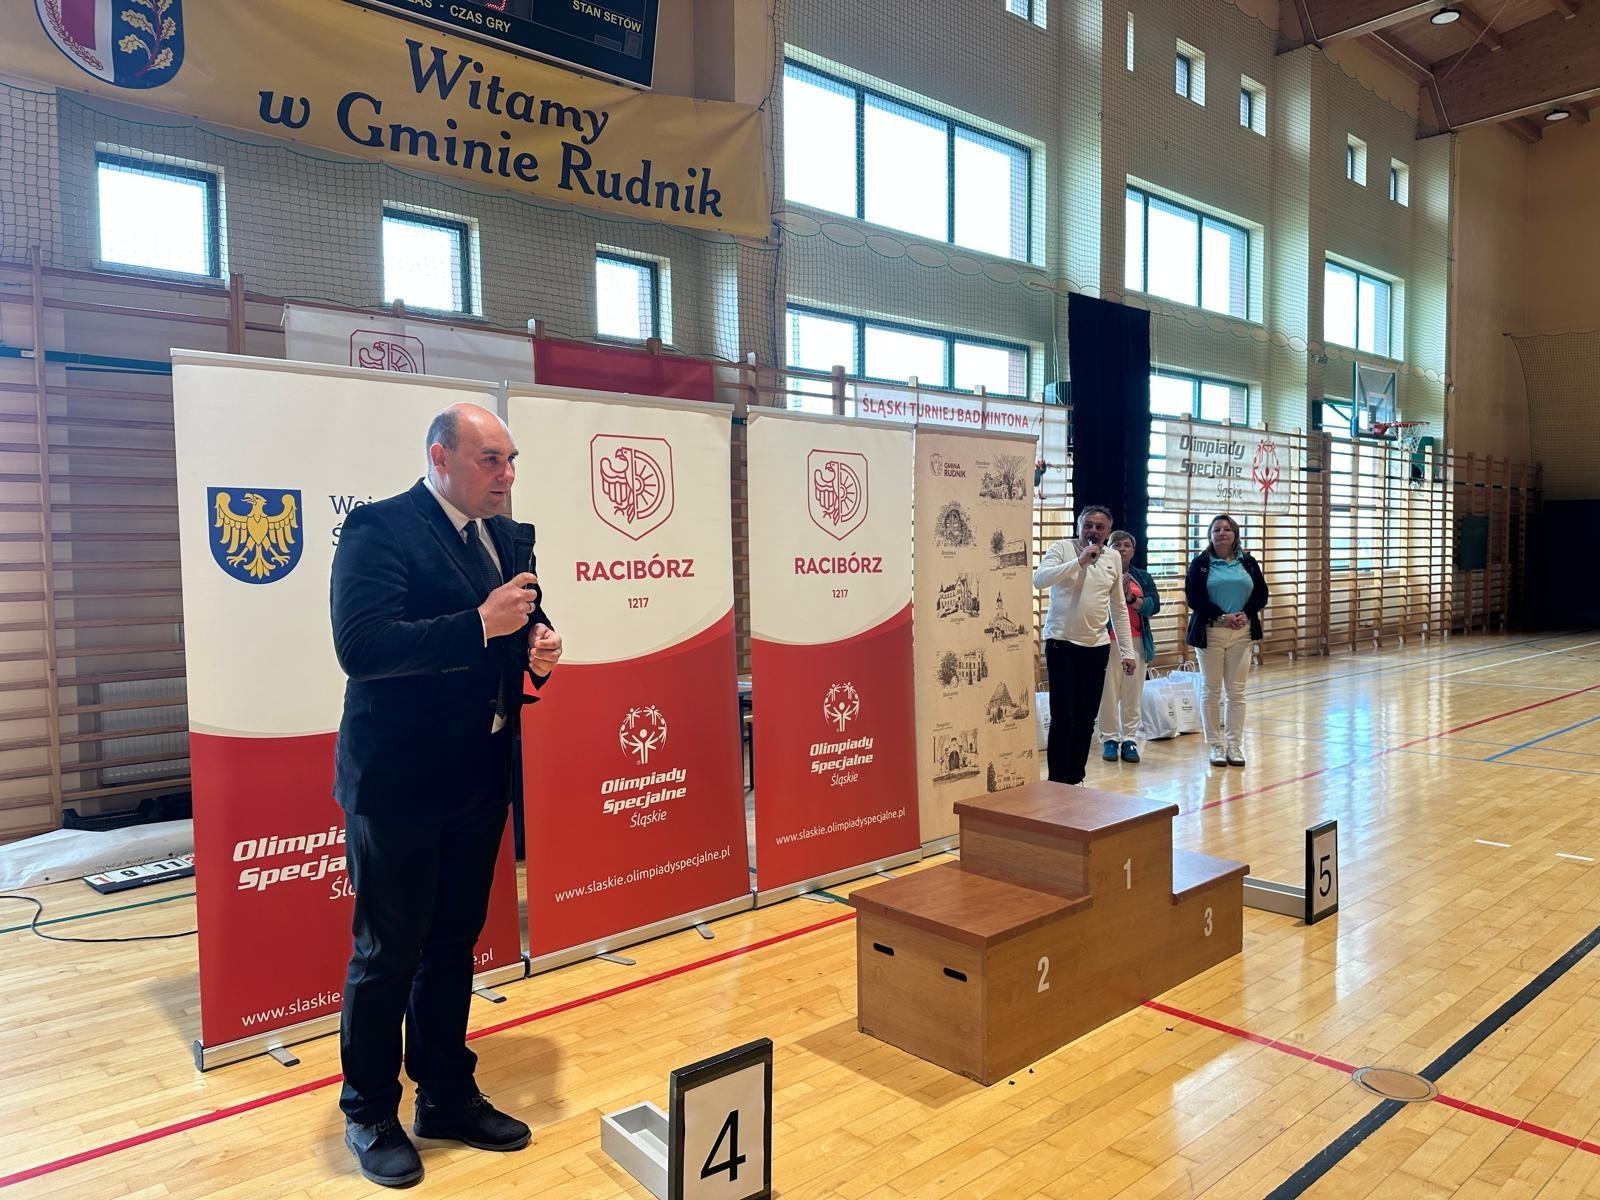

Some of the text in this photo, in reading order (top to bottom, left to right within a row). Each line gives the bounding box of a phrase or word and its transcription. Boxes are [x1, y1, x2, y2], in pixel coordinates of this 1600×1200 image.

[449, 4, 483, 25] CZAS
[486, 16, 511, 33] GRY
[572, 0, 642, 33] STAN SETÓW
[405, 38, 609, 145] Witamy
[258, 90, 723, 218] w Gminie Rudnik
[862, 393, 1029, 428] ŚLĄSKI TURNIEJ BADMINTONA
[1179, 434, 1245, 460] Olimpiady
[943, 462, 961, 470] GMINA
[943, 469, 967, 478] RUDNIK
[1180, 458, 1243, 479] Specjalne
[576, 553, 695, 582] RACIBÓRZ
[794, 551, 883, 575] RACIBÓRZ
[627, 597, 649, 609] 1217
[832, 589, 849, 599] 1217
[809, 736, 874, 757] Olimpiady
[811, 753, 874, 775] Specjalne
[601, 767, 687, 795] Olimpiady
[830, 771, 859, 787] Śląskie
[602, 787, 687, 815] Specjalne
[630, 809, 667, 828] Śląskie
[776, 806, 906, 846] www.slaskie.olimpiadyspecjalne.pl
[232, 825, 346, 862] Olimpia
[237, 854, 347, 892] Specja
[555, 845, 731, 903] www.slaskie.olimpiadyspecjalne.pl
[1123, 857, 1132, 891] 1
[1319, 854, 1332, 897] 5
[1204, 906, 1213, 937] 3
[1037, 955, 1050, 993] 2
[241, 989, 344, 1027] www.slaskie.
[700, 1109, 747, 1182] 4
